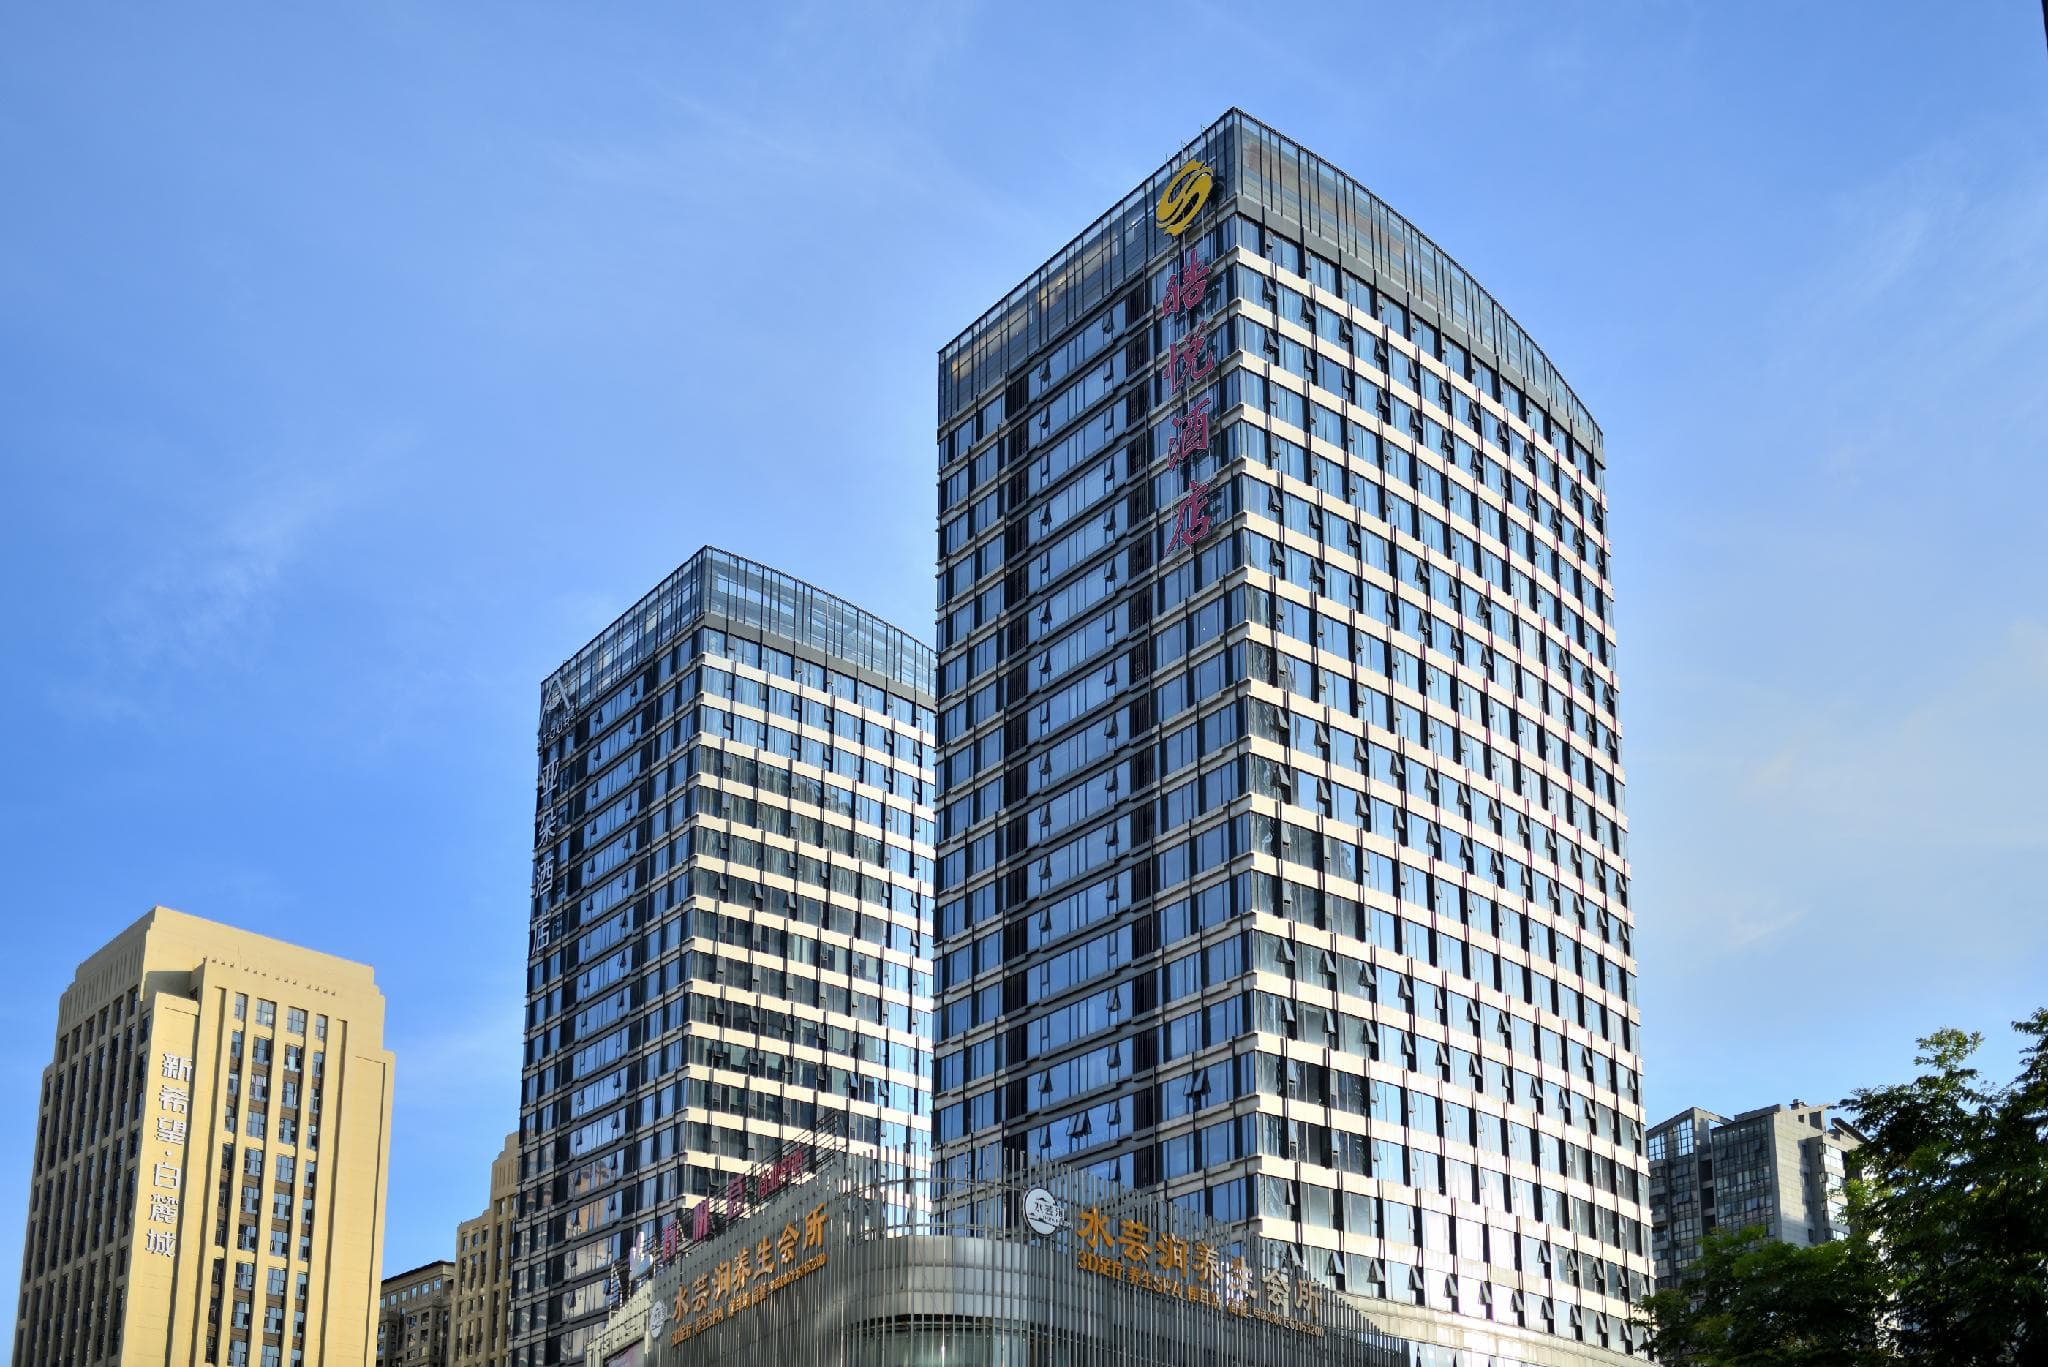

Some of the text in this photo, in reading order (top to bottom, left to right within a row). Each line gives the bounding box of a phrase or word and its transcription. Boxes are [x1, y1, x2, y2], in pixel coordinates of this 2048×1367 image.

[1162, 248, 1214, 557] 皓悦酒店
[532, 760, 560, 956] 亚朵酒店
[672, 1202, 829, 1323] 水芸润养生会所
[1077, 1206, 1323, 1317] 水芸润养生会所
[1077, 1250, 1125, 1282] 3D足疗
[1127, 1265, 1183, 1297] 养生SPA
